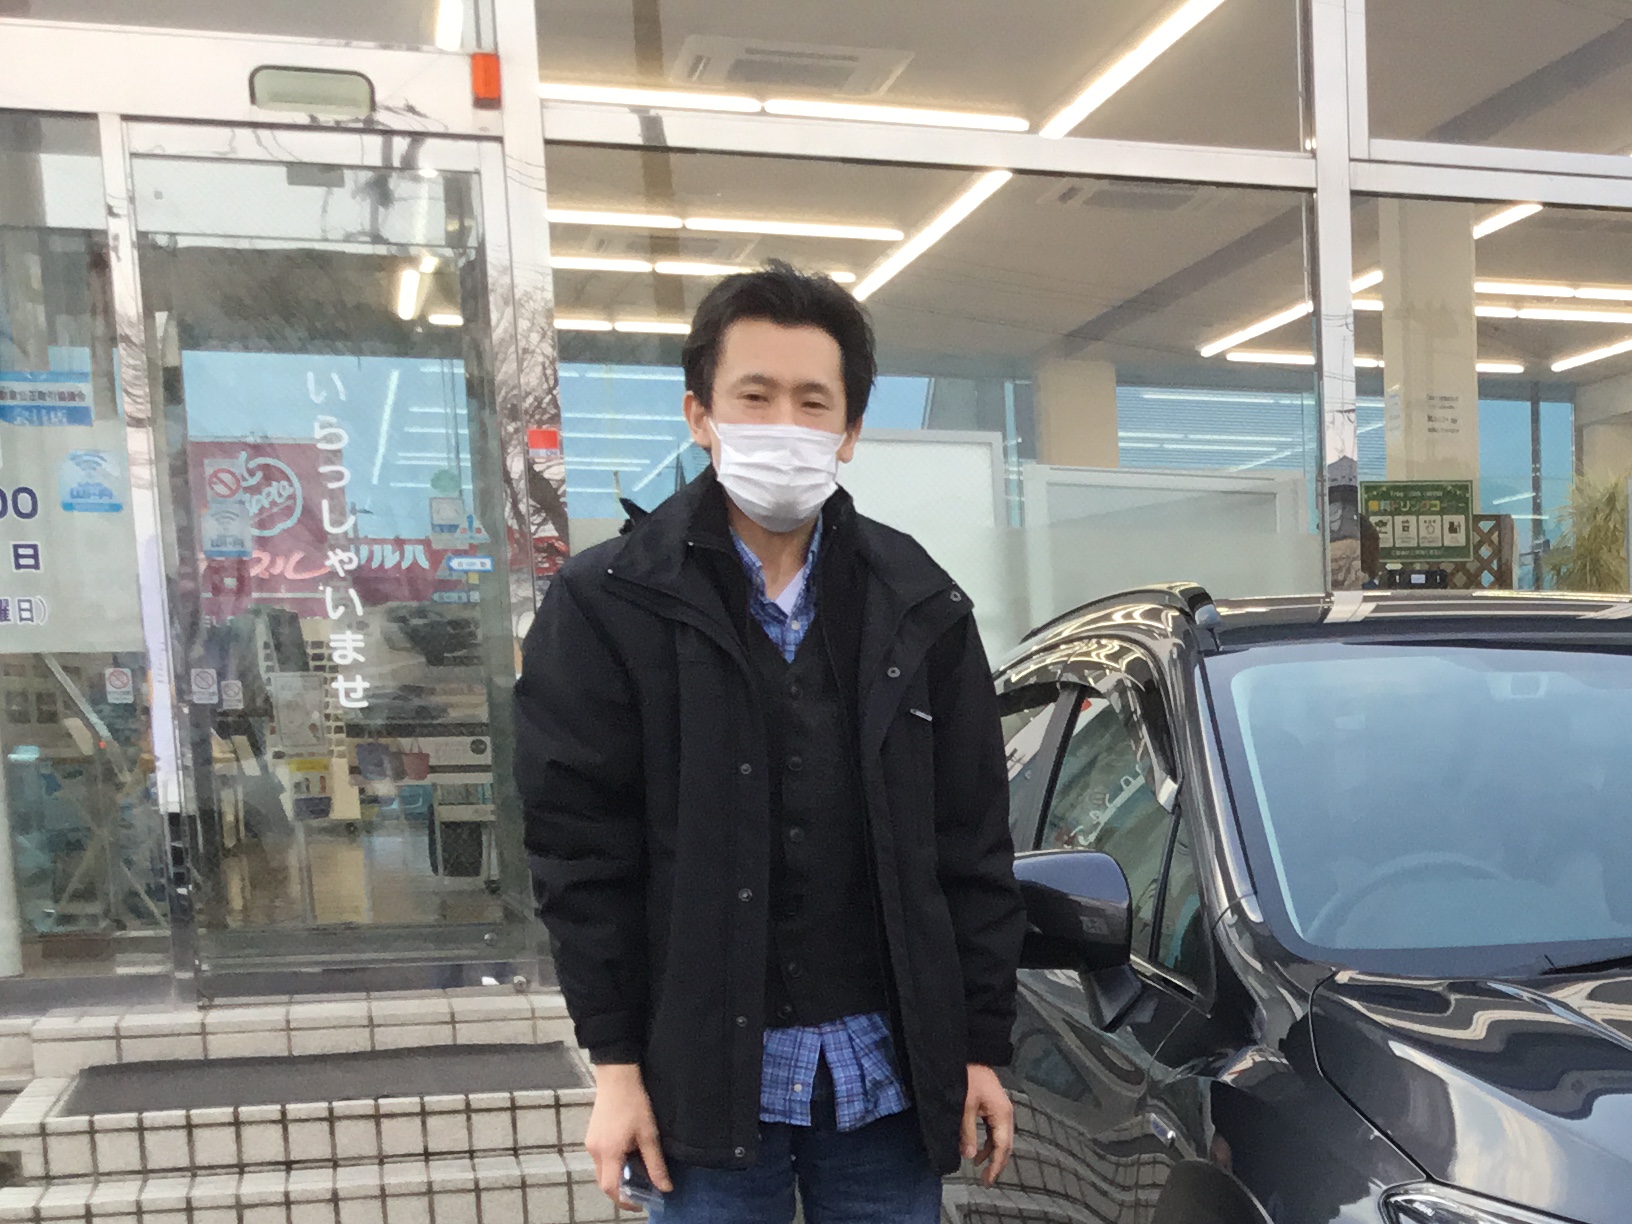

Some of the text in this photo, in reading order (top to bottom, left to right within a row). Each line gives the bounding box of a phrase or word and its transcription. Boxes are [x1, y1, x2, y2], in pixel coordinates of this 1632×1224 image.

[12, 543, 41, 571] 日
[306, 371, 370, 708] いらっしゃいませ
